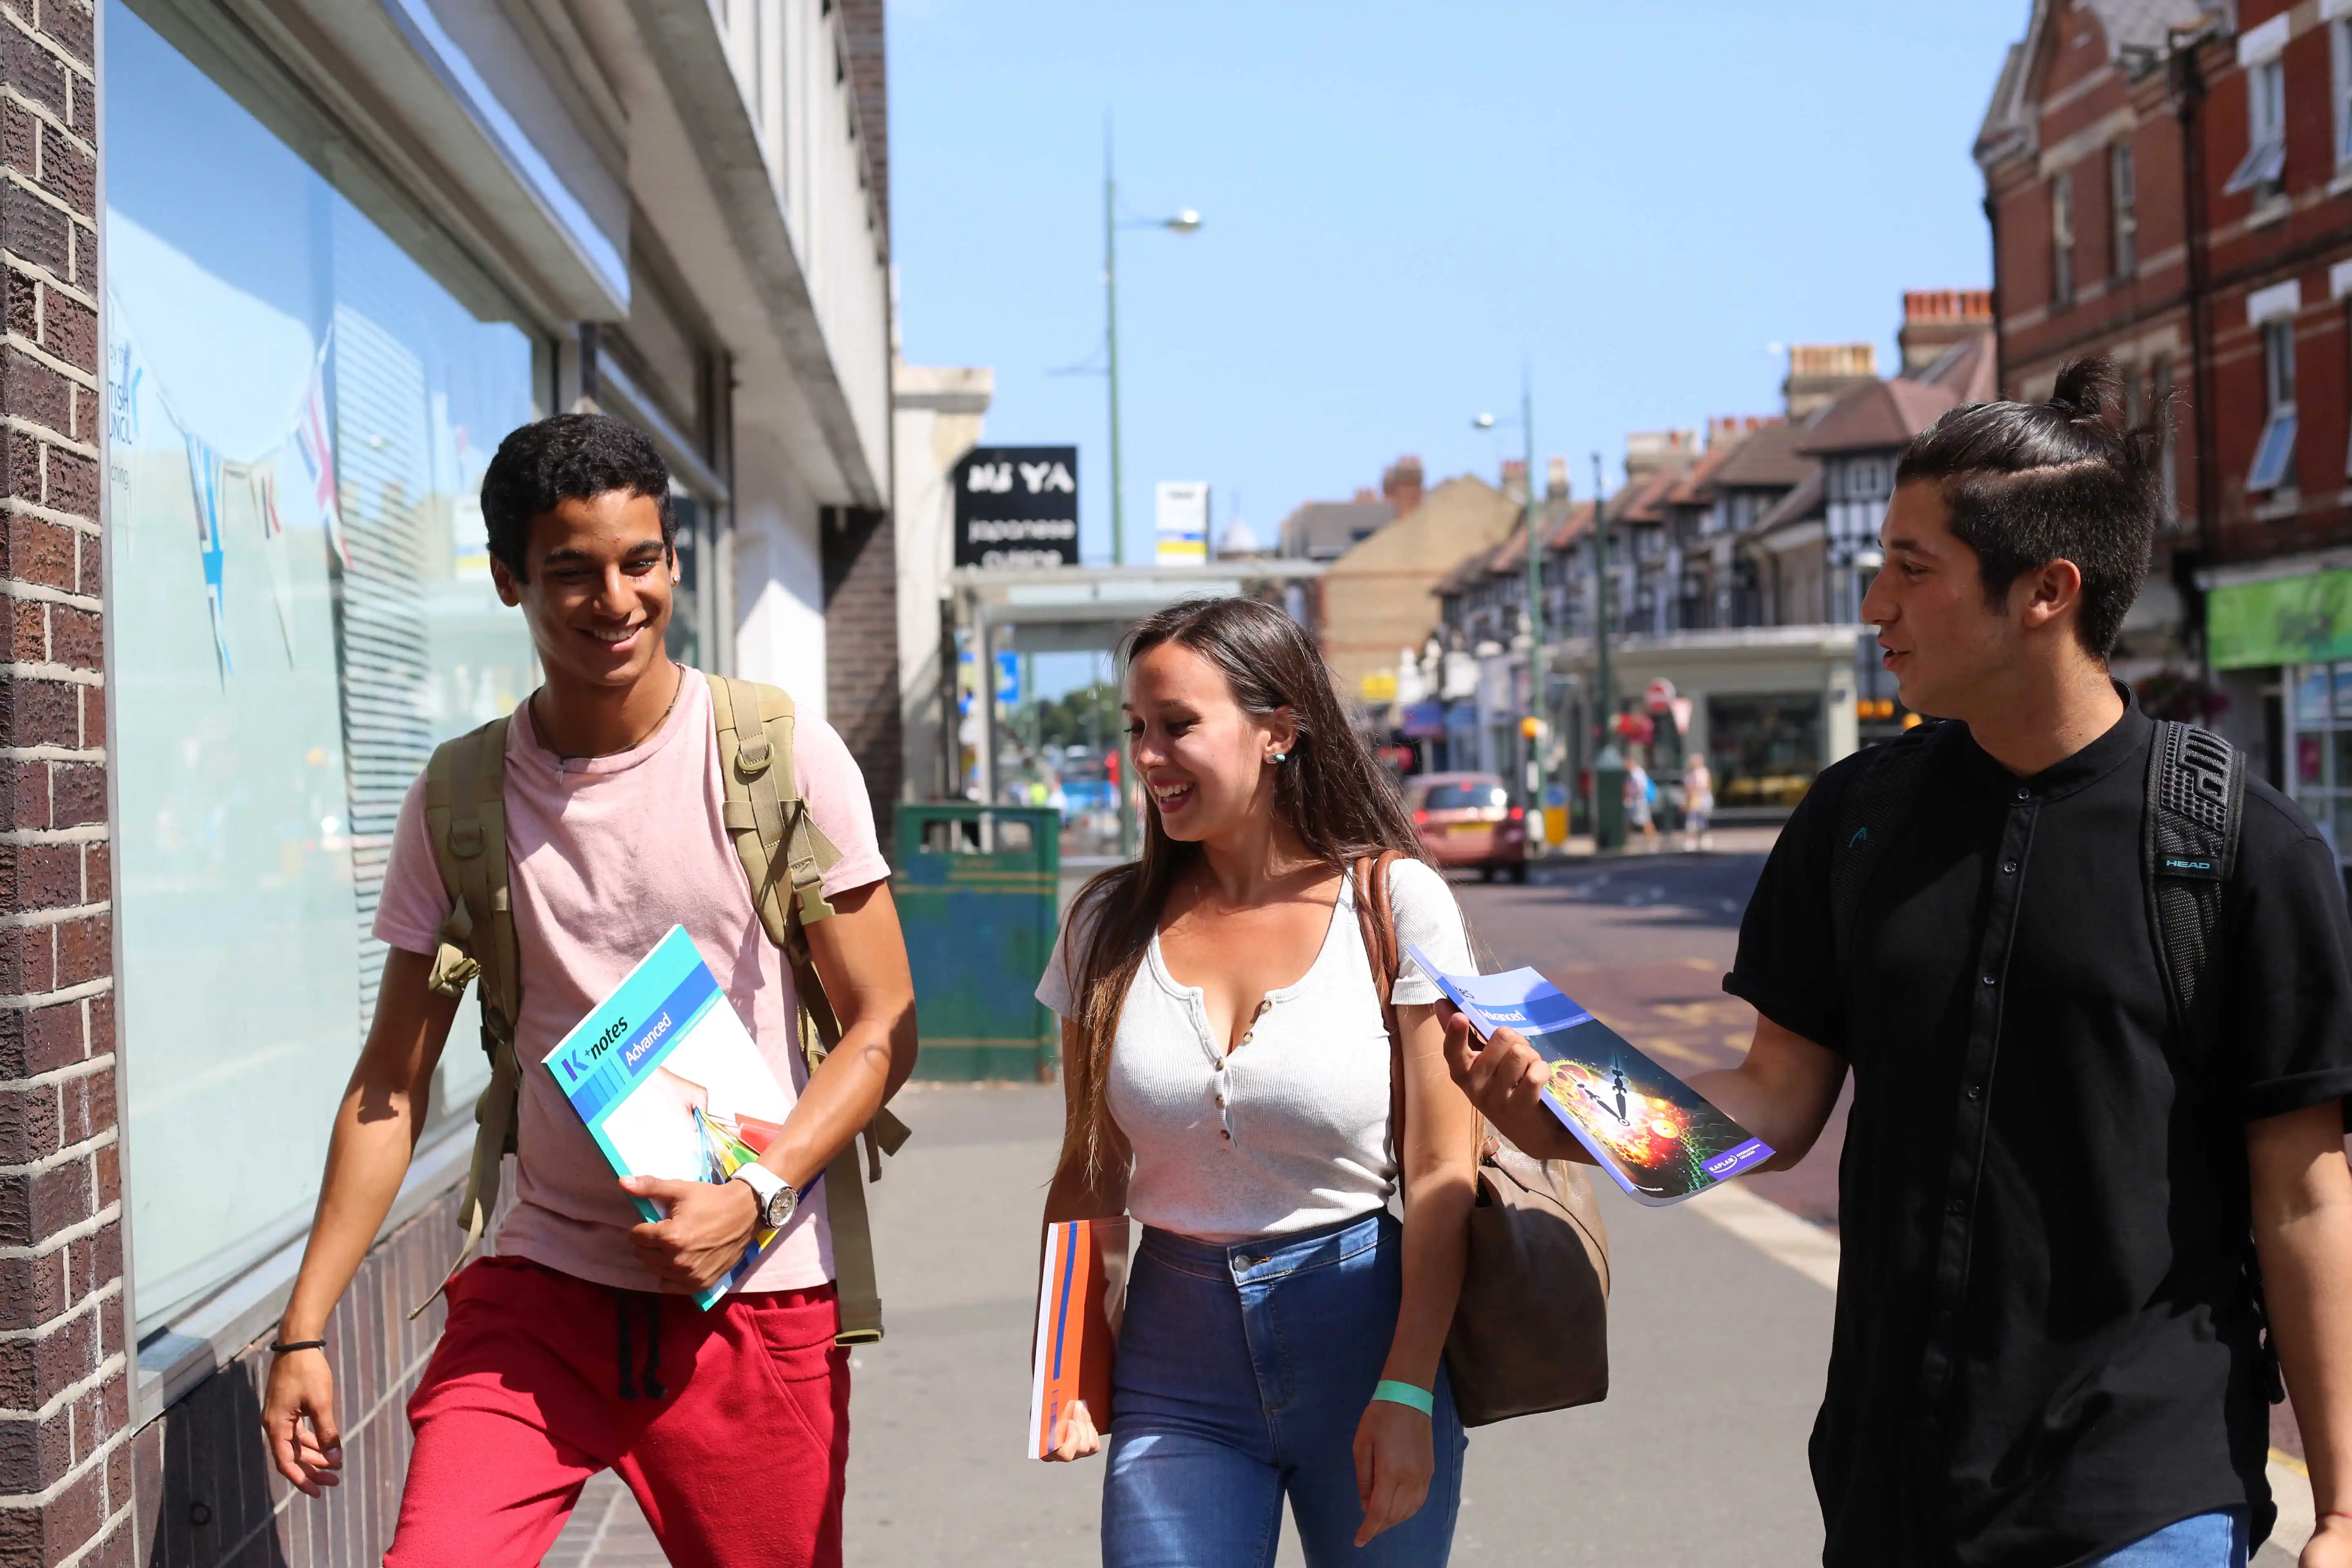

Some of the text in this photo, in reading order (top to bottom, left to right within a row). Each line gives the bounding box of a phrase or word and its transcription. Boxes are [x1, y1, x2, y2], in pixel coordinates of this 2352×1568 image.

[2166, 860, 2210, 869] HEAD
[1478, 1009, 1527, 1021] Advanced
[626, 1012, 672, 1066] Advanced
[1708, 1143, 1761, 1172] KAPLAN INTERNATIONAL
[1739, 1150, 1756, 1160] COLLEGES
